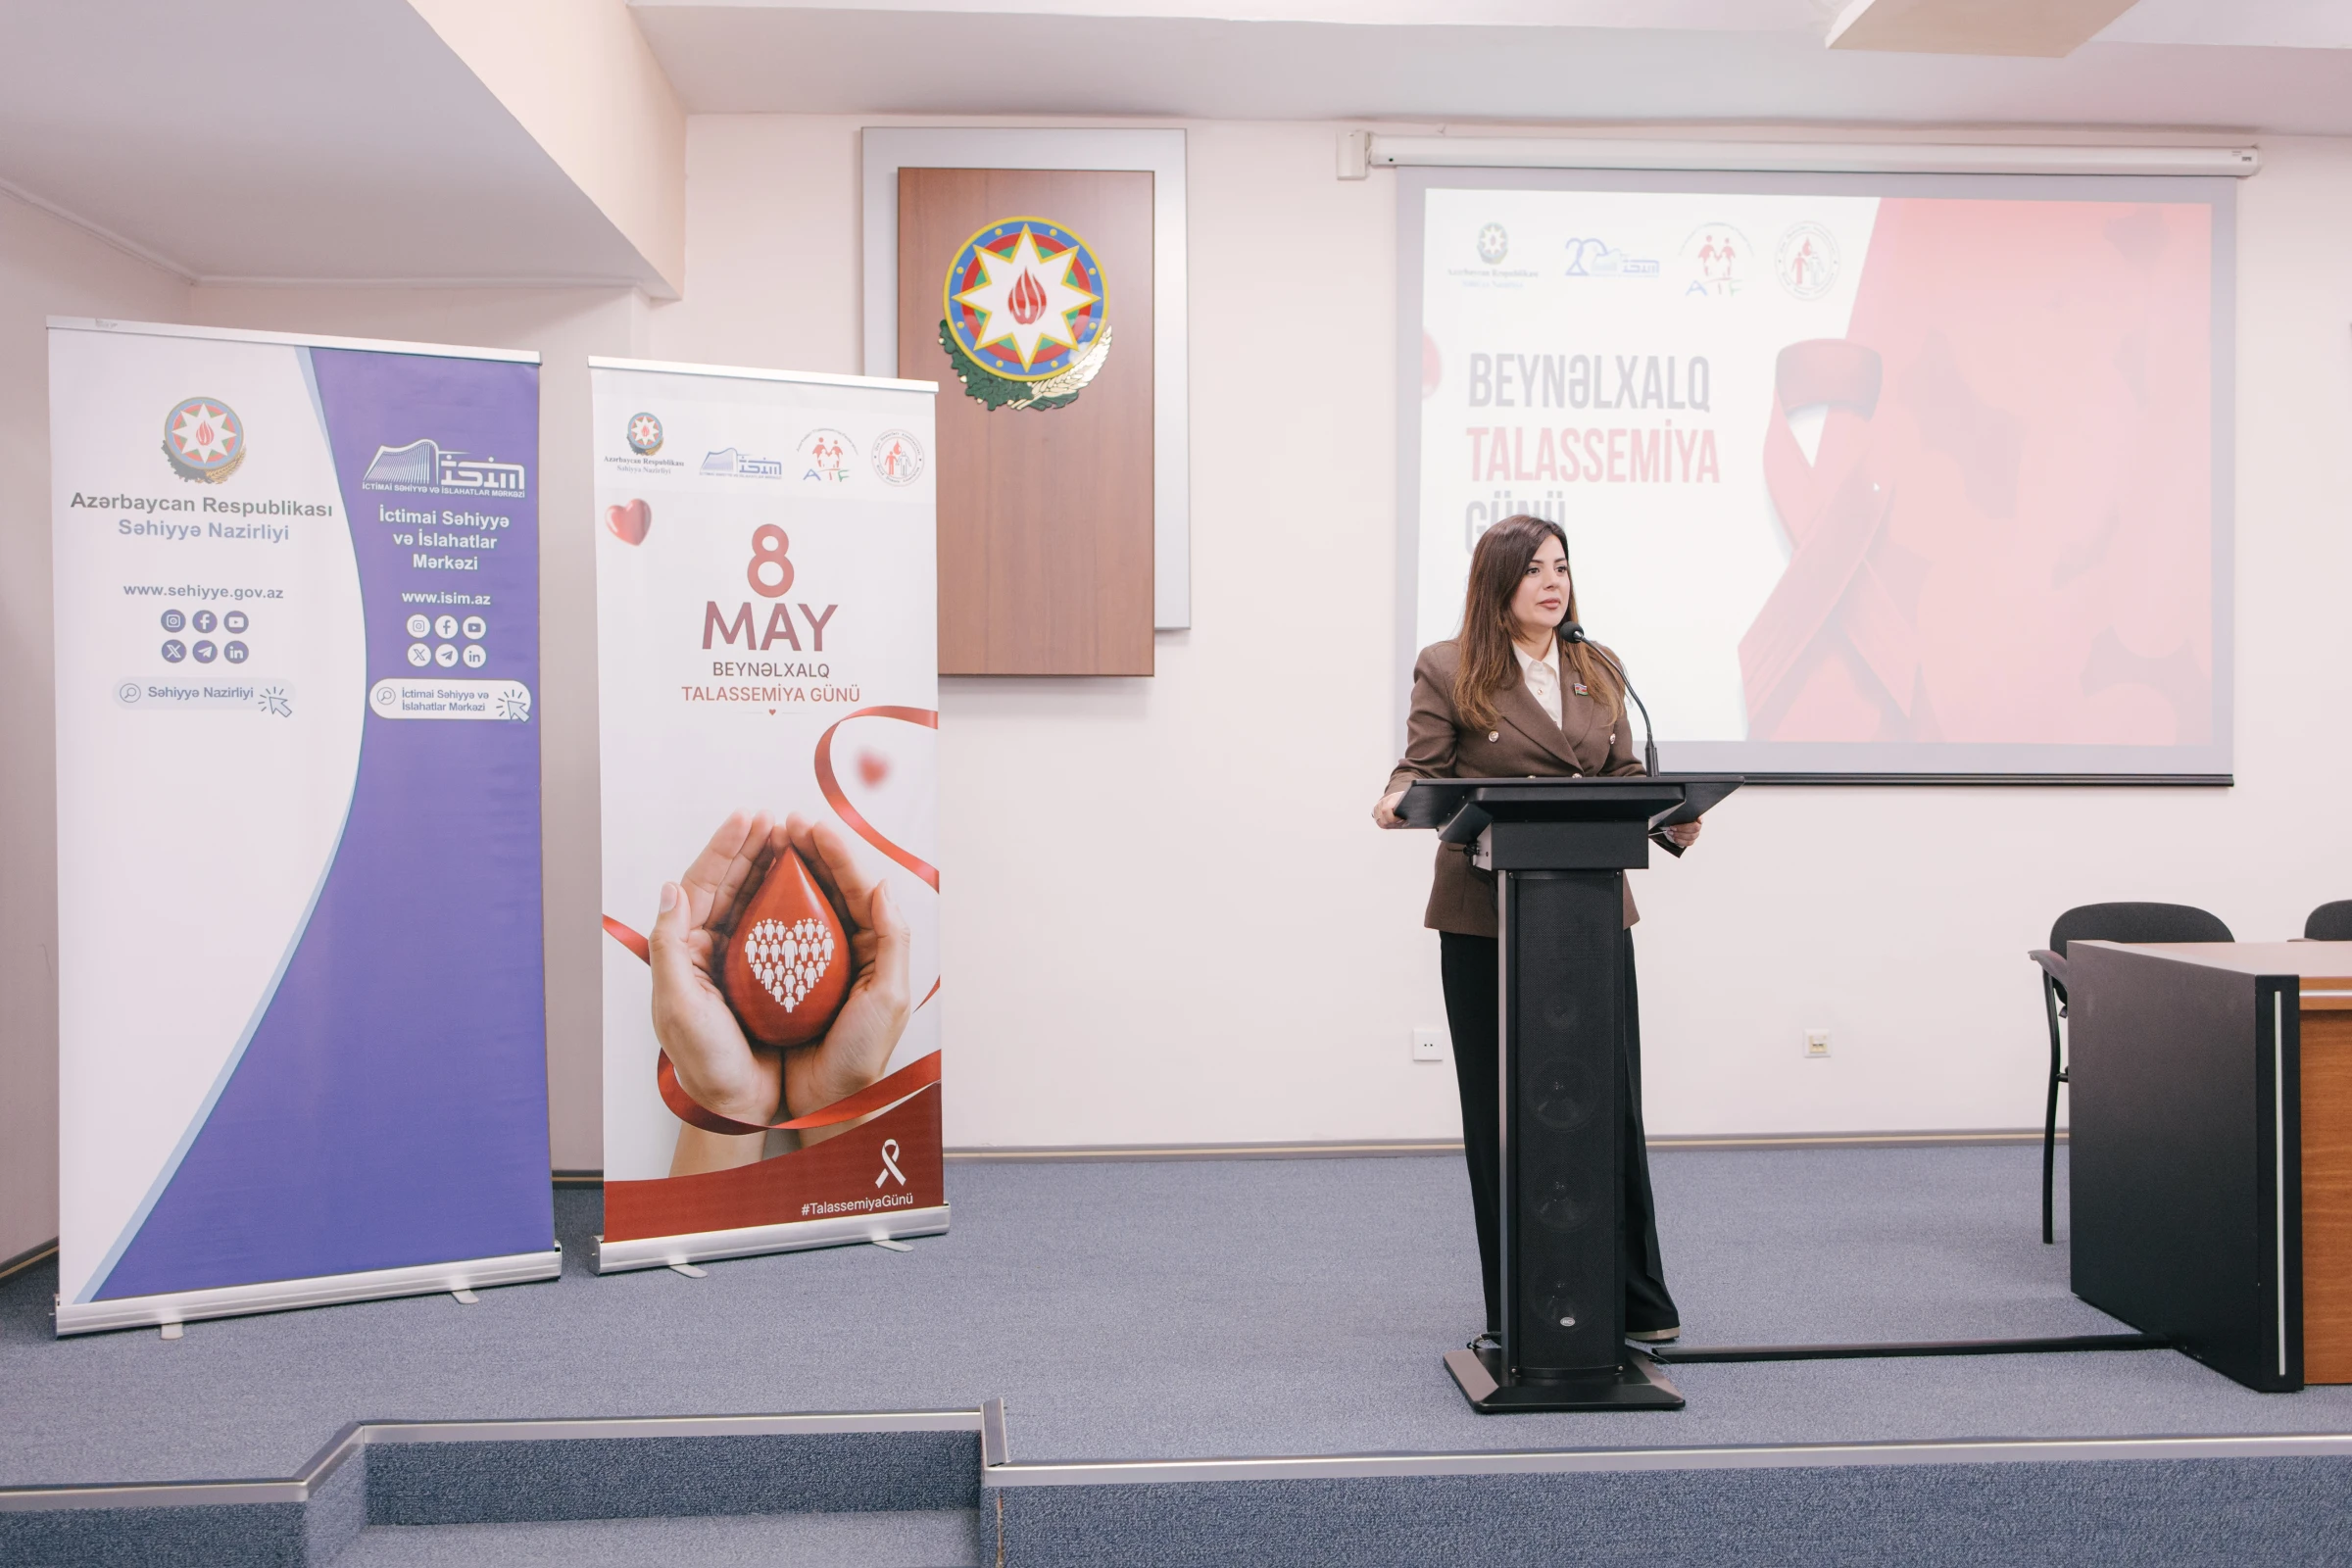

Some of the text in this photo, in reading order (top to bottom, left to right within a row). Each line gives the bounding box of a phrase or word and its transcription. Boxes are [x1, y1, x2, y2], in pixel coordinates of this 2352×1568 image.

[1468, 353, 1710, 413] BEYNƏLXALQ
[1465, 418, 1721, 484] TALASSEMİYA
[70, 492, 333, 517] Azərbaycan Respublikası
[379, 504, 510, 531] İctimai Səhiyyə
[118, 518, 290, 544] Səhiyyə Nazirliyi
[392, 528, 498, 550] və İslahatlar
[413, 553, 479, 570] Mərkəzi
[746, 523, 795, 599] 8
[122, 584, 284, 601] www.sehiyye.gov.az
[401, 591, 492, 606] www.isim.az
[701, 600, 840, 653] MAY
[712, 661, 831, 679] BEYNƏLXALQ
[148, 686, 254, 701] Səhiyyə Nazirliyi
[402, 686, 434, 699] İctimai
[437, 689, 475, 701] Səhiyyə
[681, 683, 860, 703] TALASSEMİYA GÜNÜ
[402, 701, 486, 711] İslahatlar Mərkəzi
[801, 1192, 914, 1217] #TalassemiyaGünü
